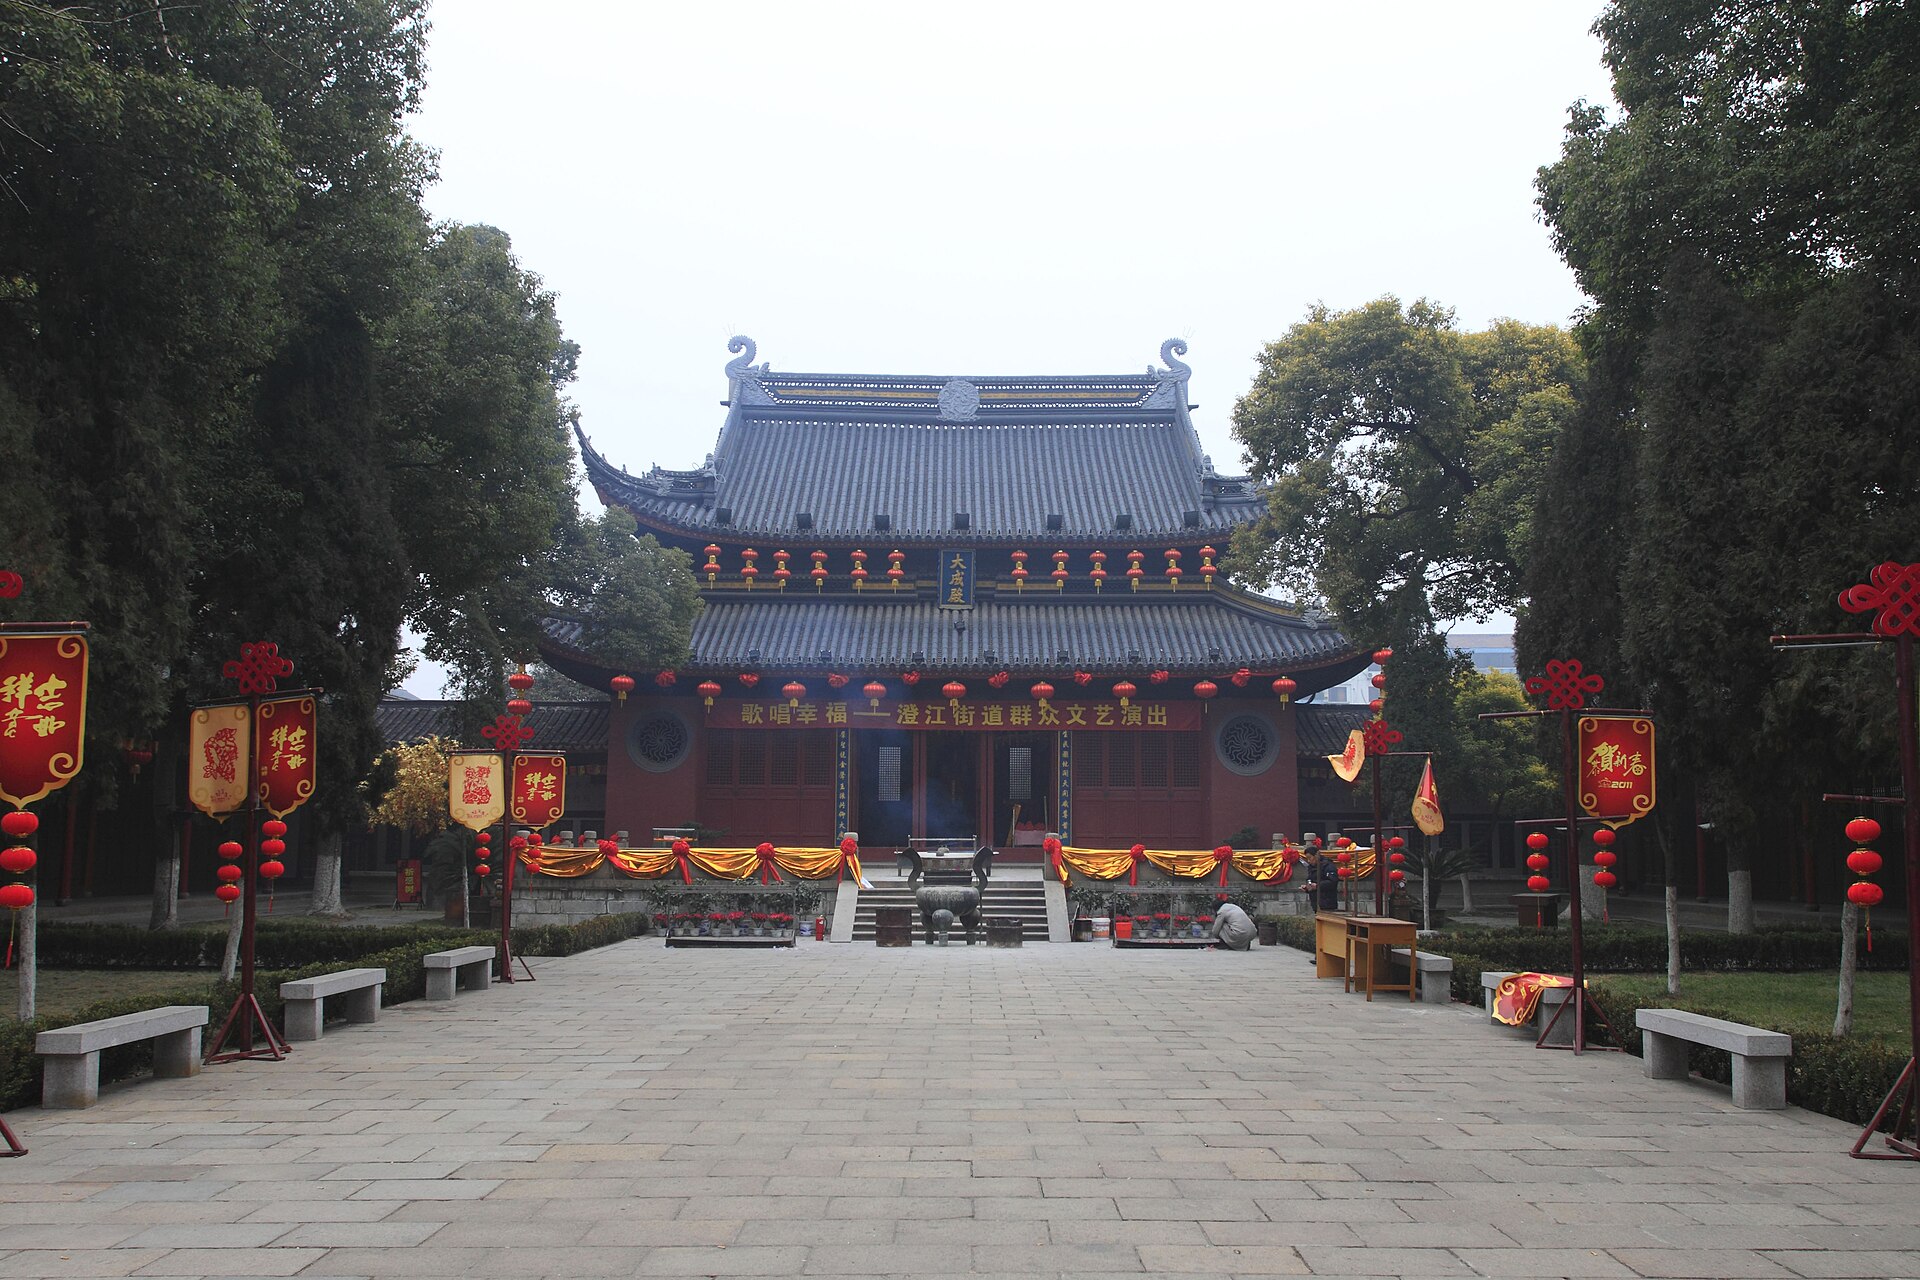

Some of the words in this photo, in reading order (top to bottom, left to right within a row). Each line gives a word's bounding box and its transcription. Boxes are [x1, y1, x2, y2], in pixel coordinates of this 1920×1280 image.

[947, 553, 967, 603] 大成殿
[1611, 781, 1633, 789] 2011
